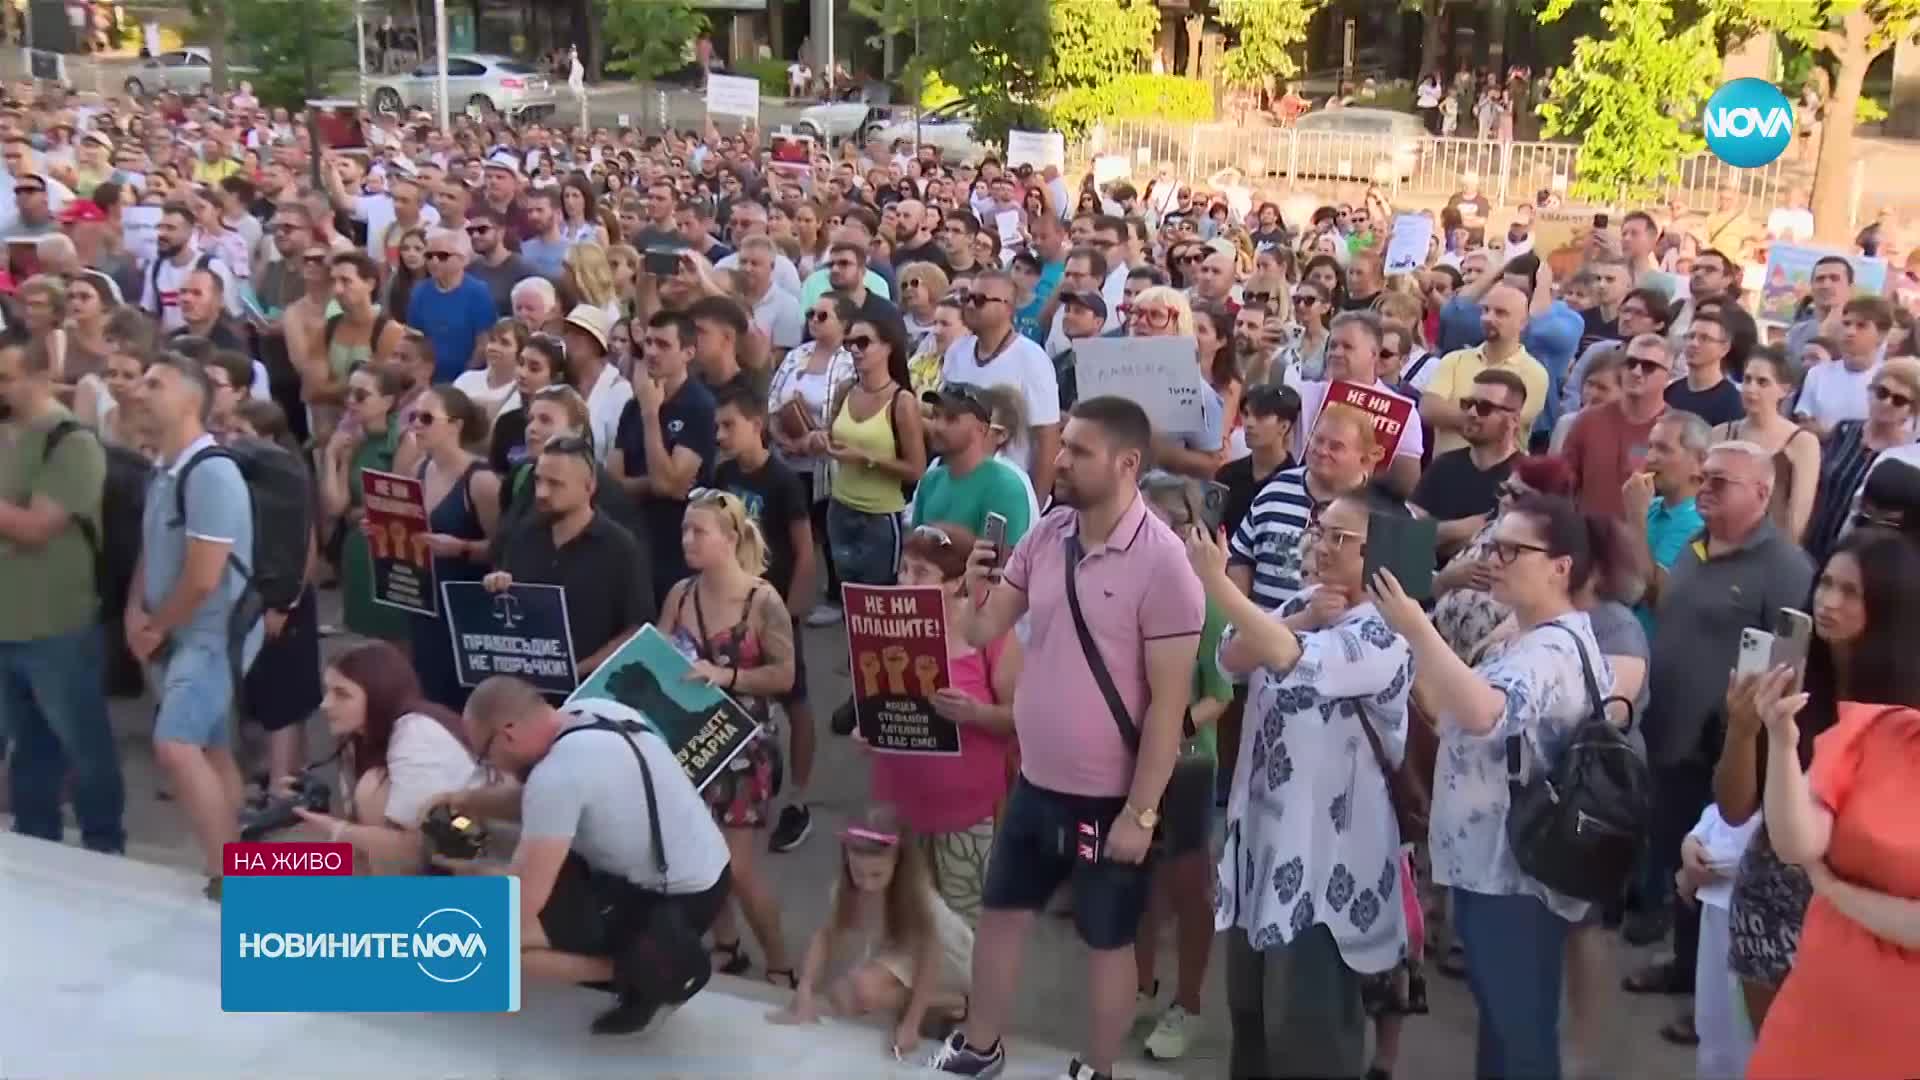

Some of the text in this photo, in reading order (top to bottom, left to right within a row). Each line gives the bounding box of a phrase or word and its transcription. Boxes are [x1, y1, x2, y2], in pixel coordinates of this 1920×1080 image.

[1346, 390, 1391, 414] НЕ НИ
[864, 594, 917, 615] НЕ НИ
[851, 614, 941, 638] ПЛАШИТЕ!
[468, 654, 490, 671] НЕ
[691, 723, 739, 770] ВАРНА
